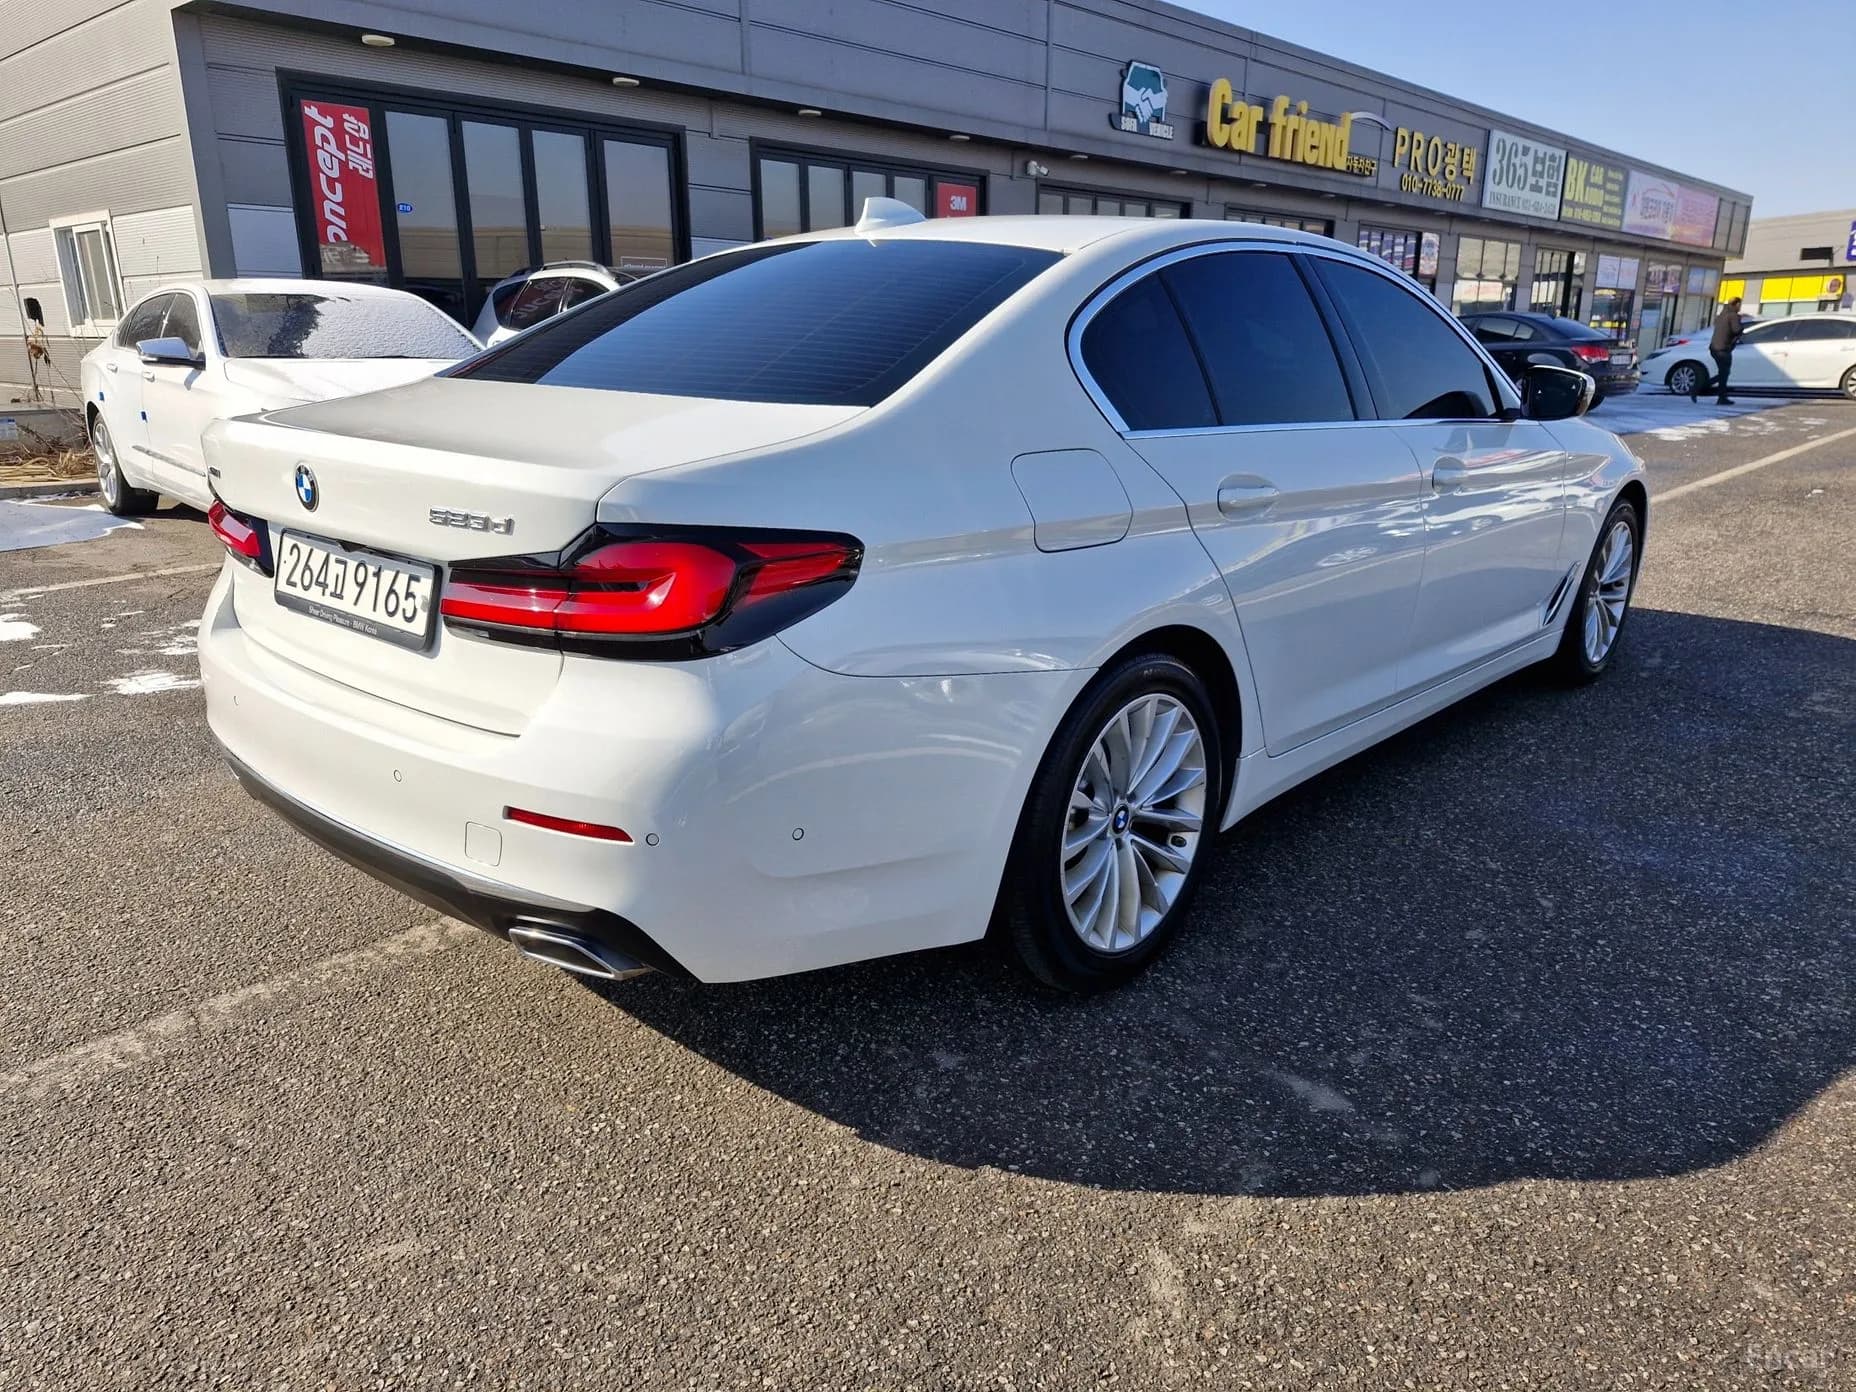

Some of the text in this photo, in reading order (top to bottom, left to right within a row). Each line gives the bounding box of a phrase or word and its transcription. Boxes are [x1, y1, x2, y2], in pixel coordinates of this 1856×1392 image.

[1207, 78, 1264, 153] Car
[1401, 173, 1465, 202] 010-7738-0777
[1564, 157, 1589, 202] BK
[949, 195, 967, 212] 3M
